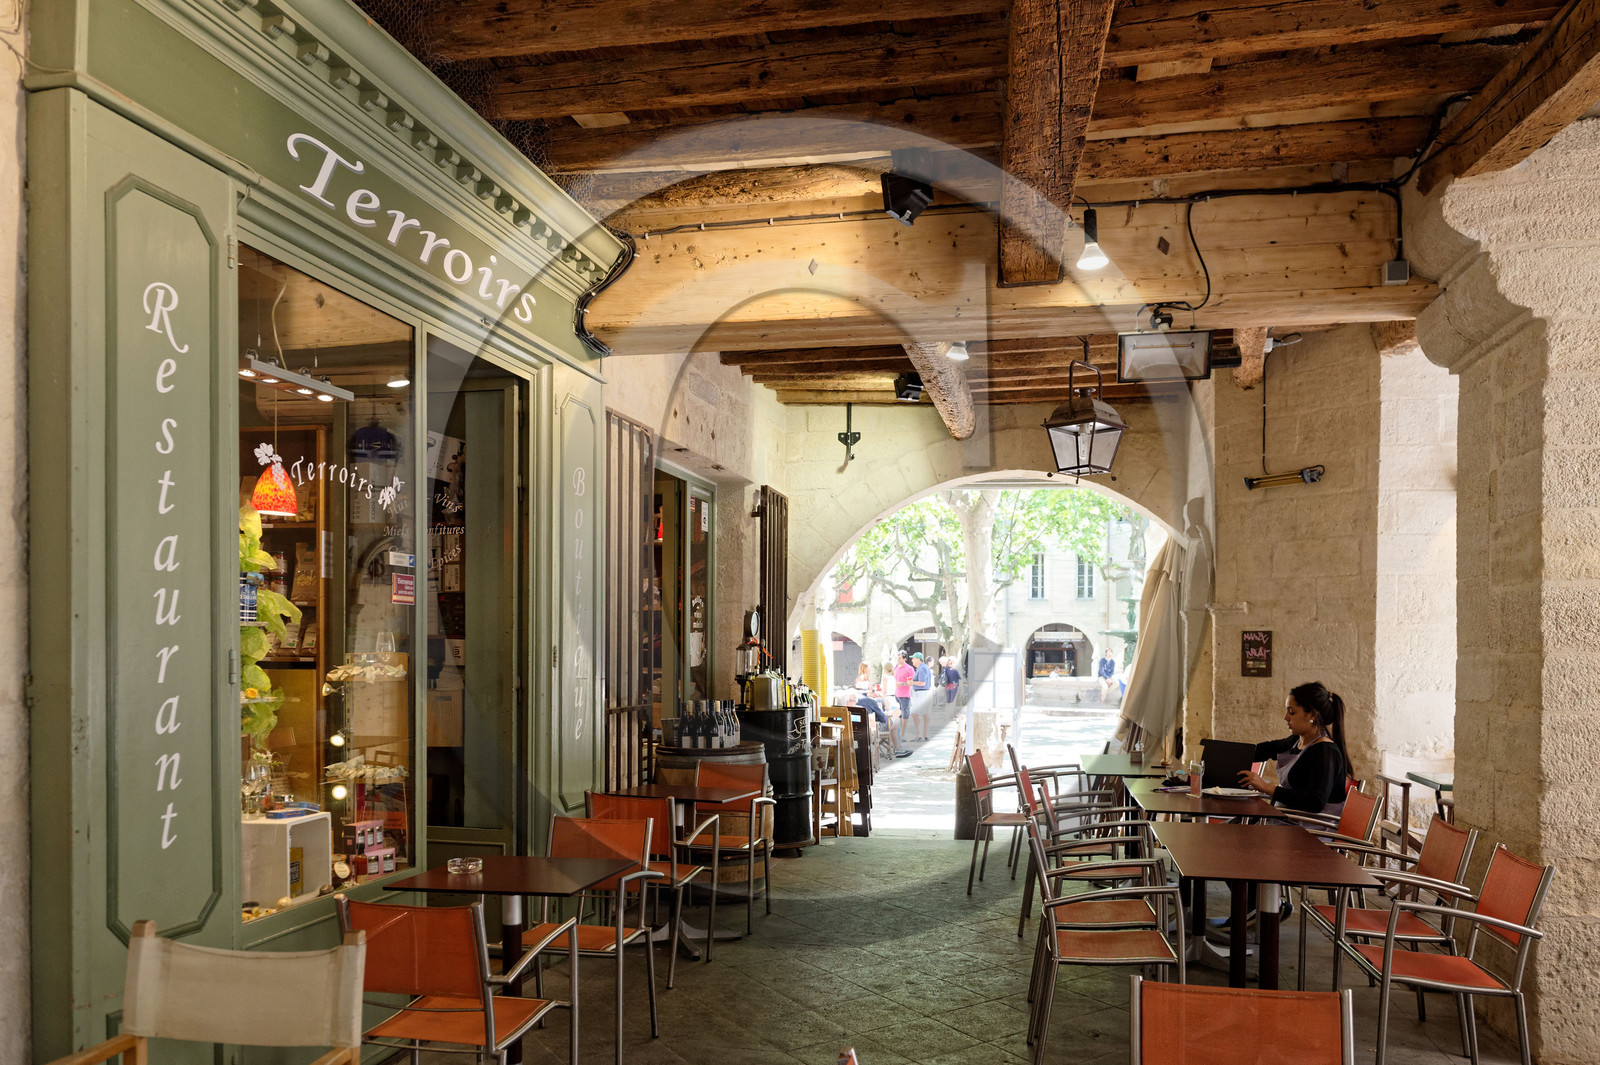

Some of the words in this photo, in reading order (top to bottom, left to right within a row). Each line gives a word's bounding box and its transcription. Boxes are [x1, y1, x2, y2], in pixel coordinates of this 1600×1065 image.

[287, 132, 537, 324] Terroirs
[291, 455, 374, 499] Terroirs
[383, 523, 410, 537] Miels
[427, 523, 465, 538] nfitures
[434, 493, 461, 513] Vins
[143, 282, 189, 850] Restaurant
[572, 467, 586, 740] Boutique
